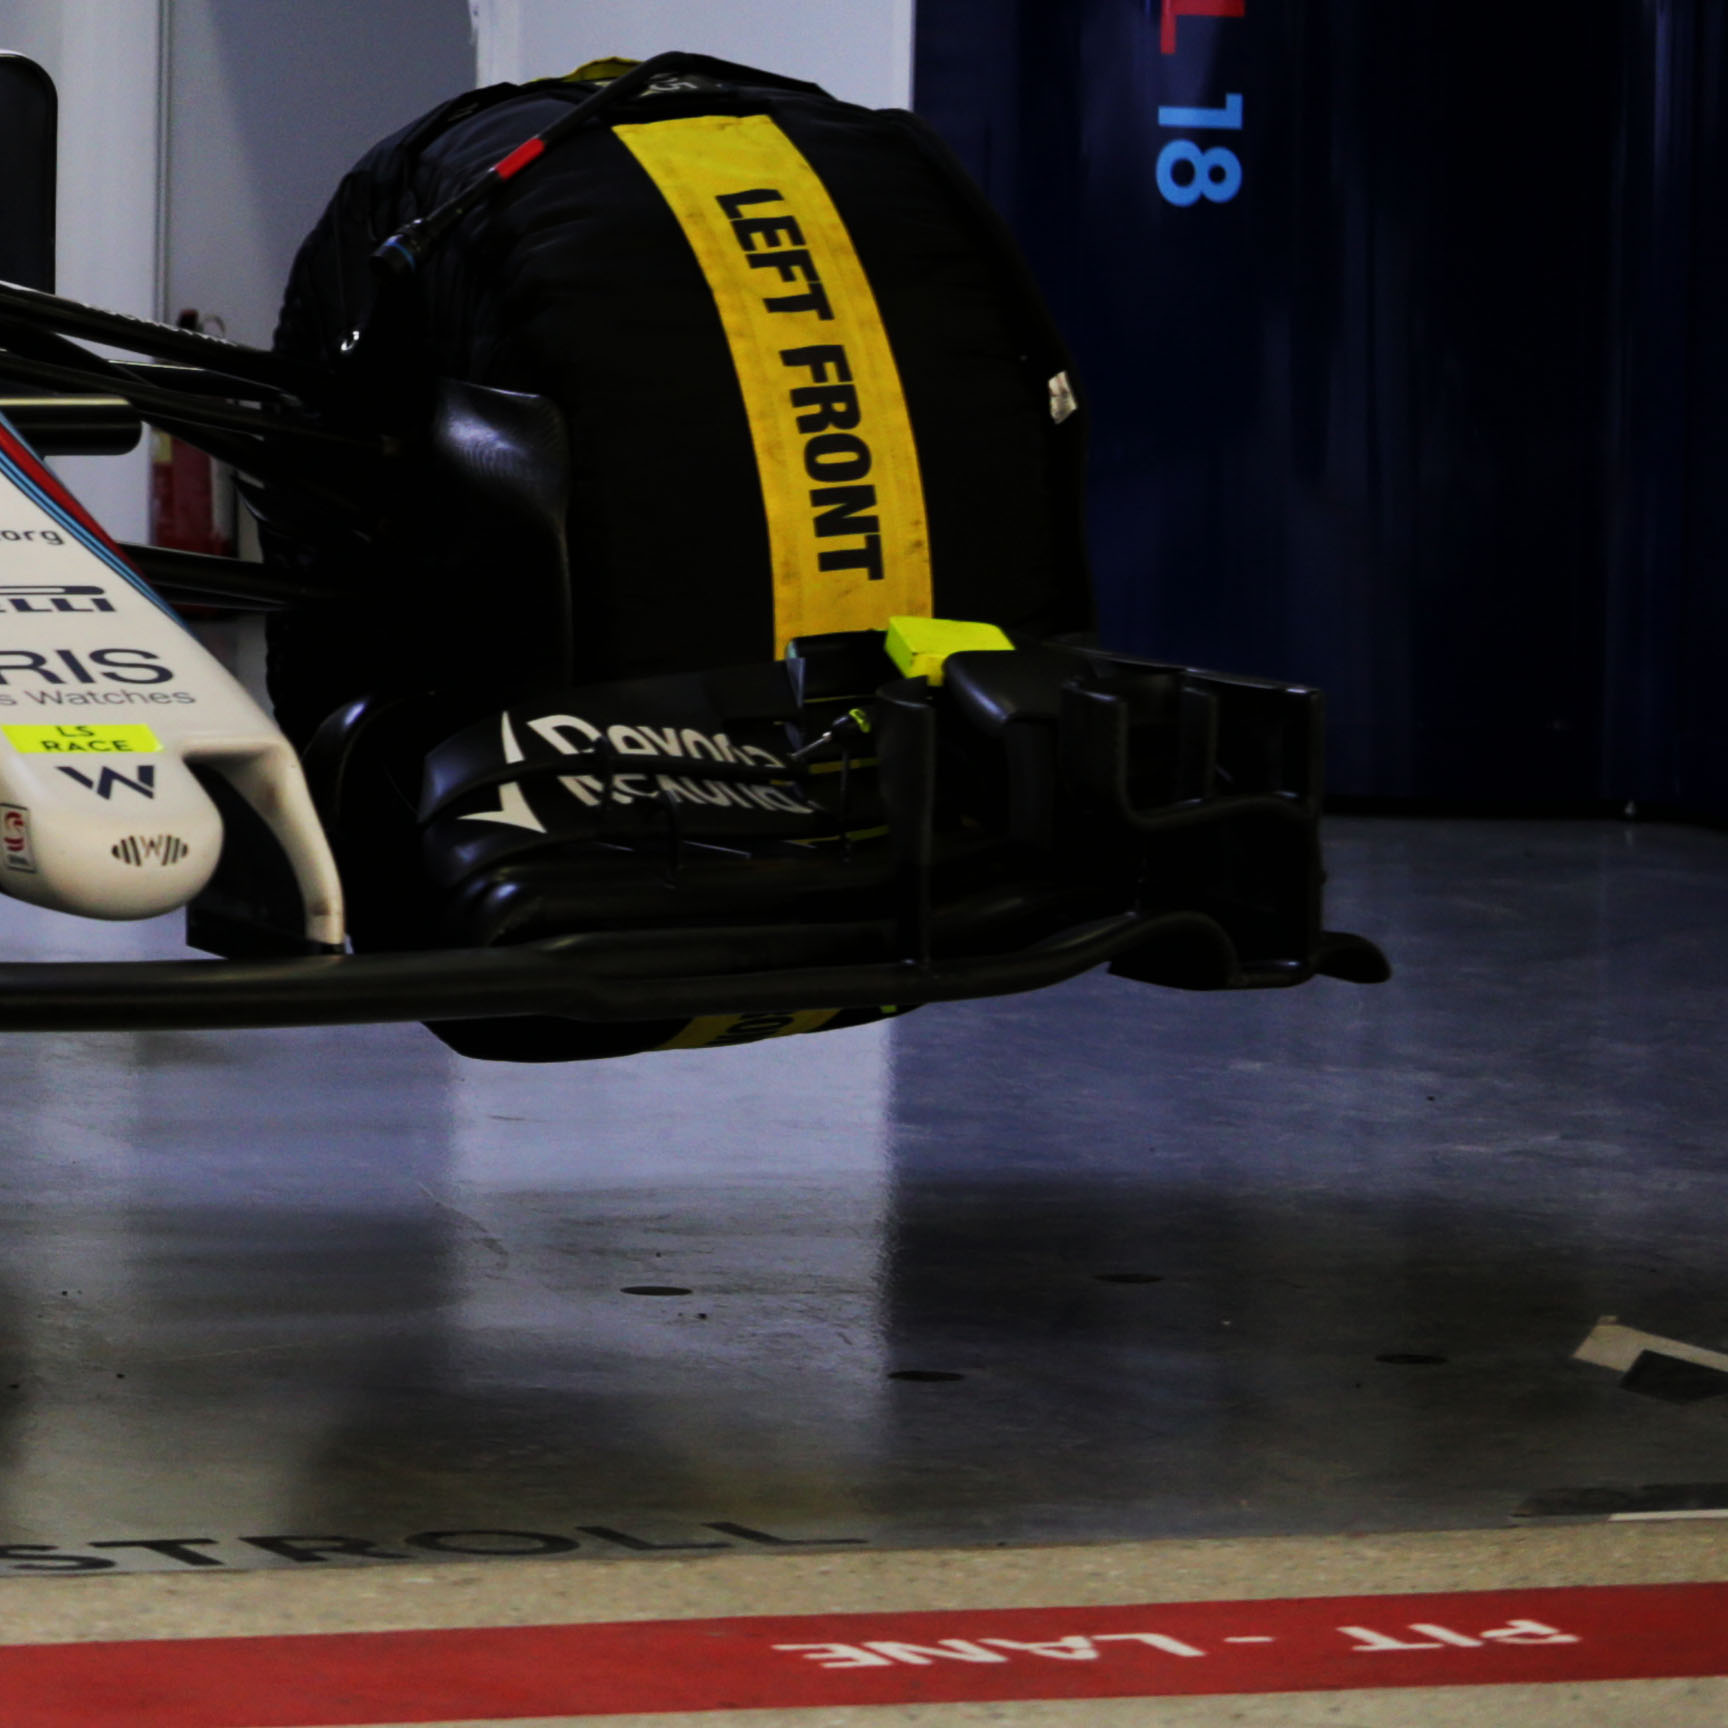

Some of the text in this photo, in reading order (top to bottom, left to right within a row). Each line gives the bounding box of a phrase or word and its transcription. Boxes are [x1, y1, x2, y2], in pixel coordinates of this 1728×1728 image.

[1155, 93, 1244, 208] 18
[714, 187, 885, 582] LEFT FRONT
[27, 688, 197, 708] Watches
[40, 740, 134, 753] RACE
[54, 725, 96, 738] LS
[770, 1632, 1206, 1669] LANE
[1337, 1618, 1580, 1652] PIT
